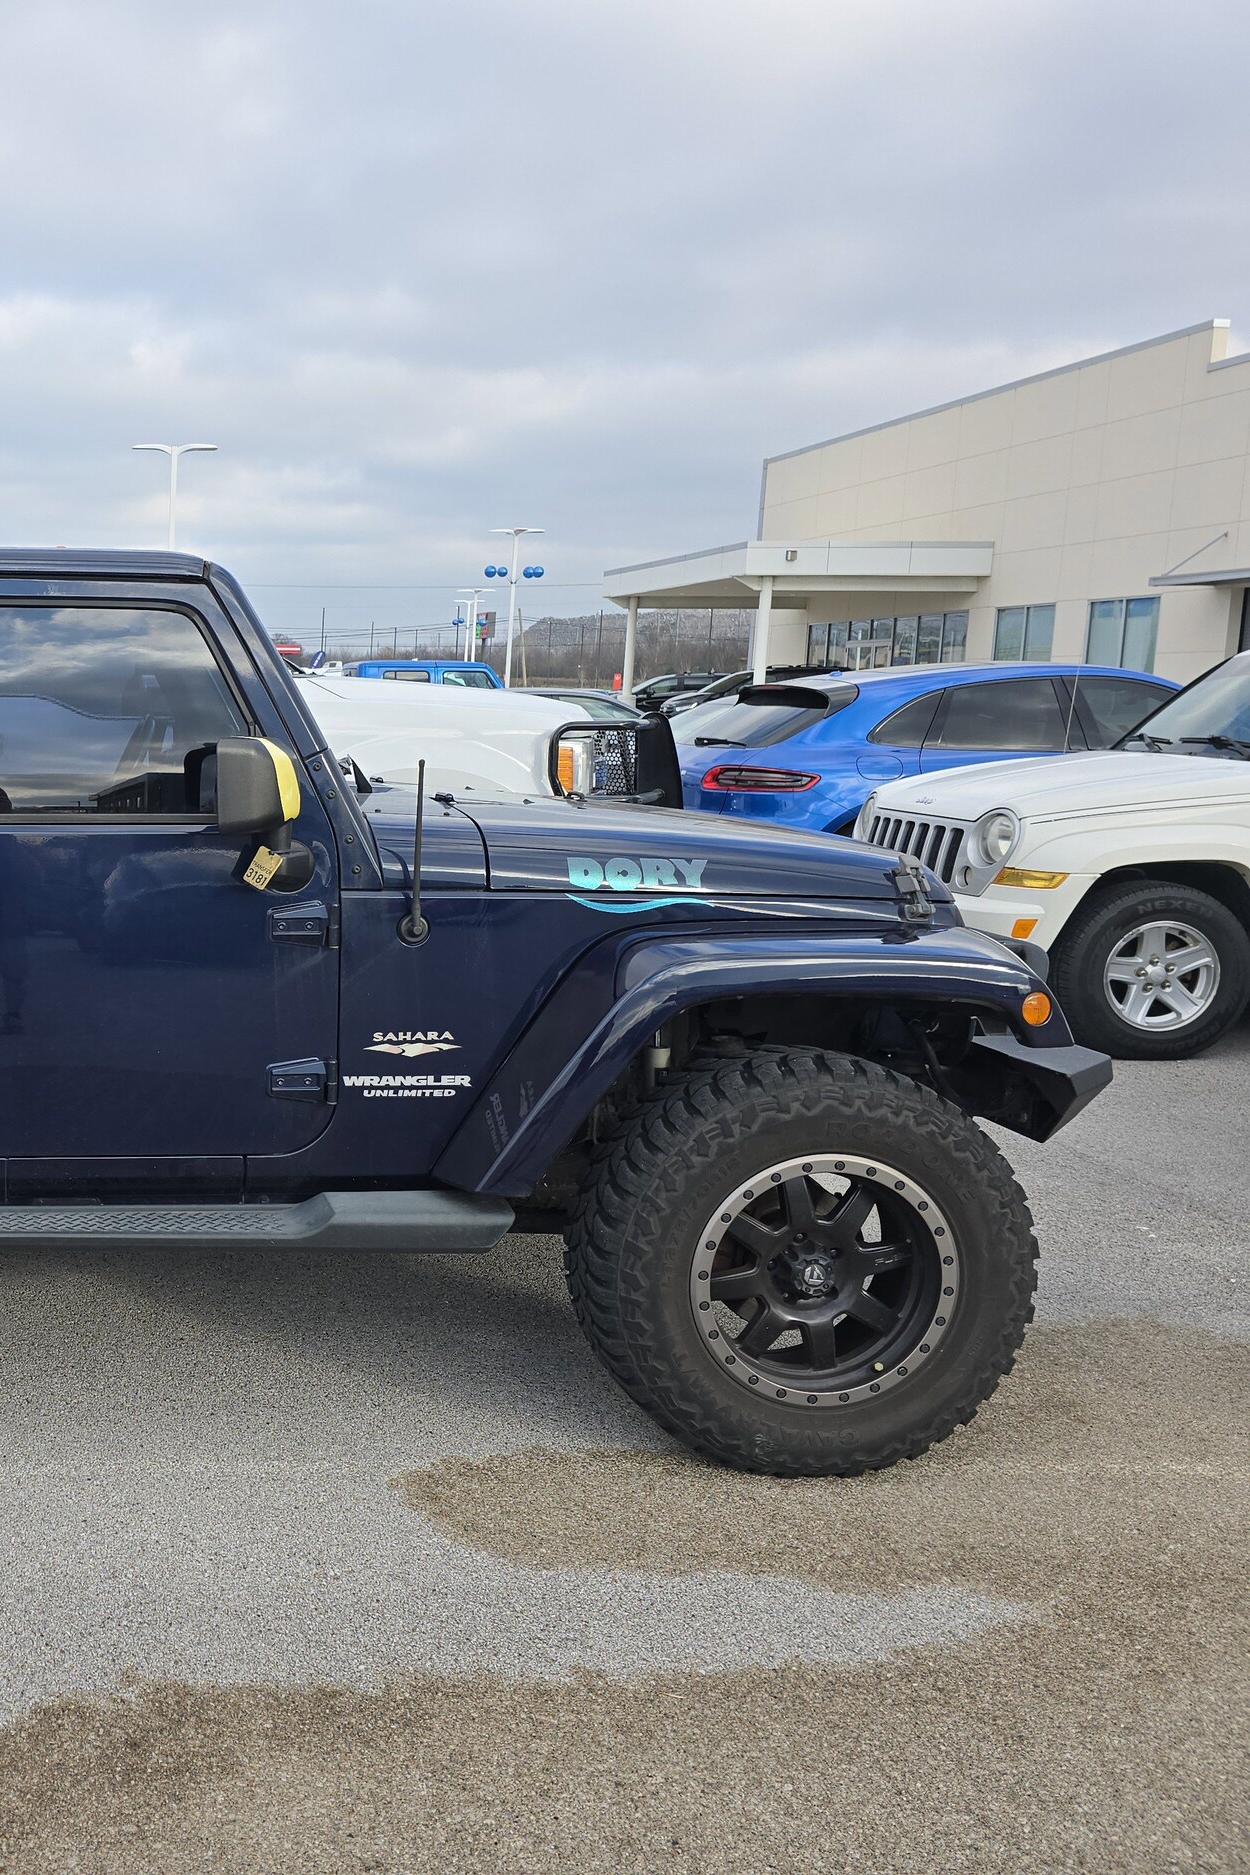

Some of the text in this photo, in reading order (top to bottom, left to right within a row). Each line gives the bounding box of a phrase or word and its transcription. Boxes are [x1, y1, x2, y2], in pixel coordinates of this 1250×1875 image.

[246, 867, 267, 886] 3181
[567, 857, 707, 891] DORY
[1136, 899, 1214, 919] NEXEN
[372, 1030, 455, 1042] SAHARA
[342, 1074, 473, 1088] WRANGLER
[362, 1088, 456, 1098] UNLIMITED
